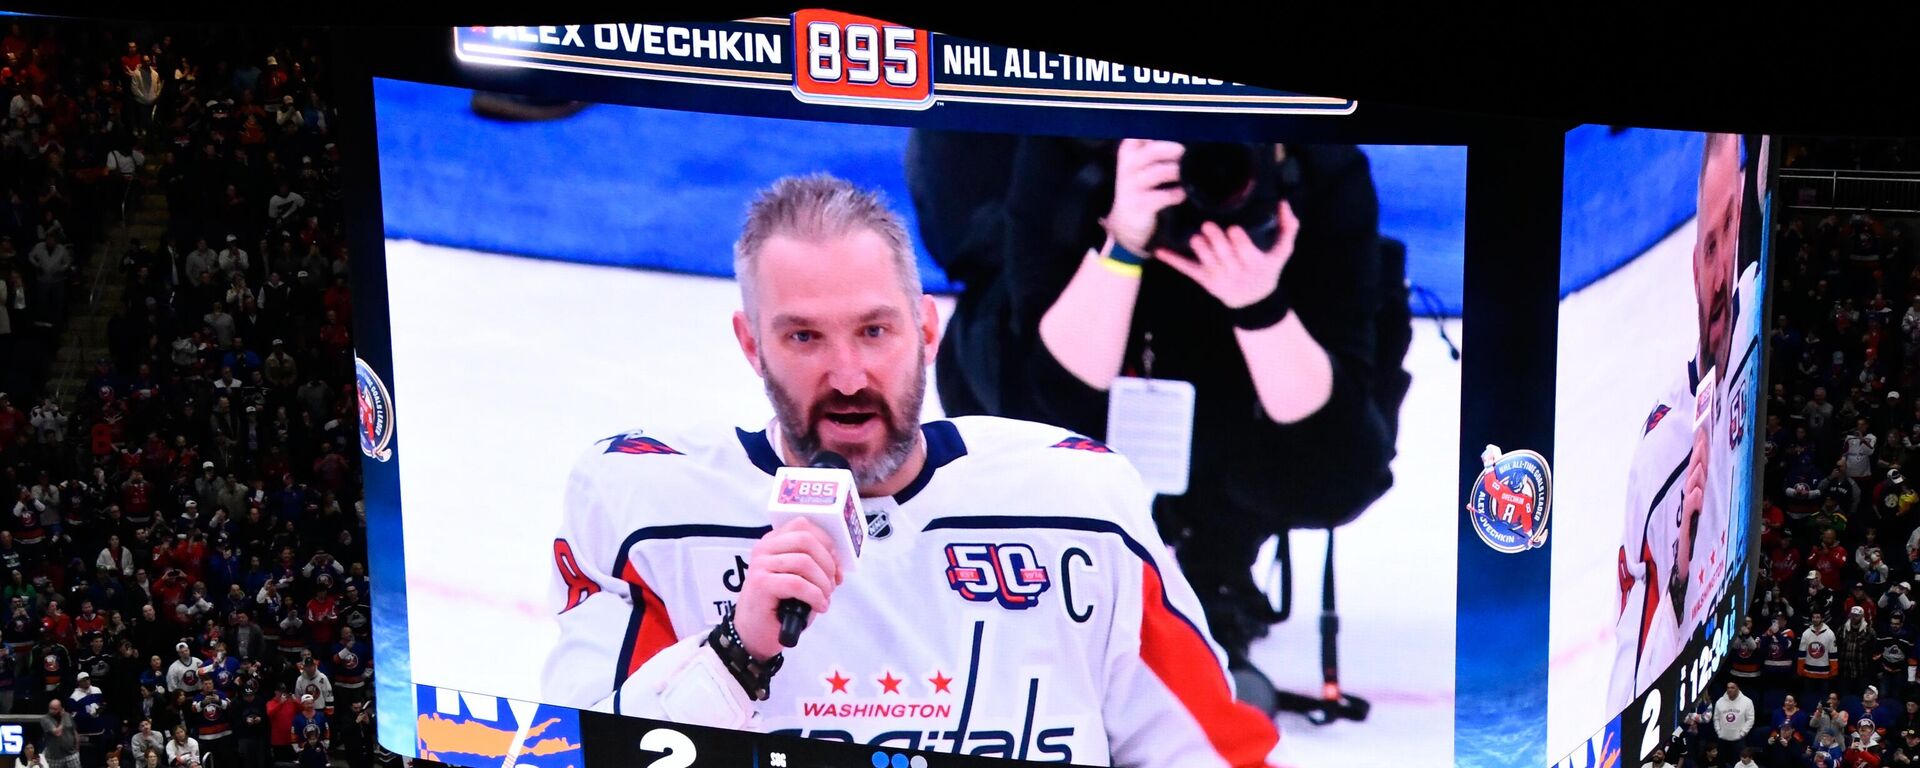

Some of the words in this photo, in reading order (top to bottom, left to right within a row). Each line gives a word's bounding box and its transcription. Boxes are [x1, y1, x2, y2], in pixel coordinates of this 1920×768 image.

[594, 23, 782, 64] OVECHKIN
[809, 23, 918, 86] 895
[943, 44, 997, 77] NHL
[1003, 47, 1127, 83] ALL-TIME
[798, 482, 836, 497] 895
[945, 543, 1050, 609] 50
[1060, 547, 1094, 623] C
[764, 620, 1074, 766] itals
[803, 702, 951, 718] WASHINGTON
[0, 724, 24, 755] 5
[1639, 688, 1662, 763] 2
[639, 728, 698, 768] 2
